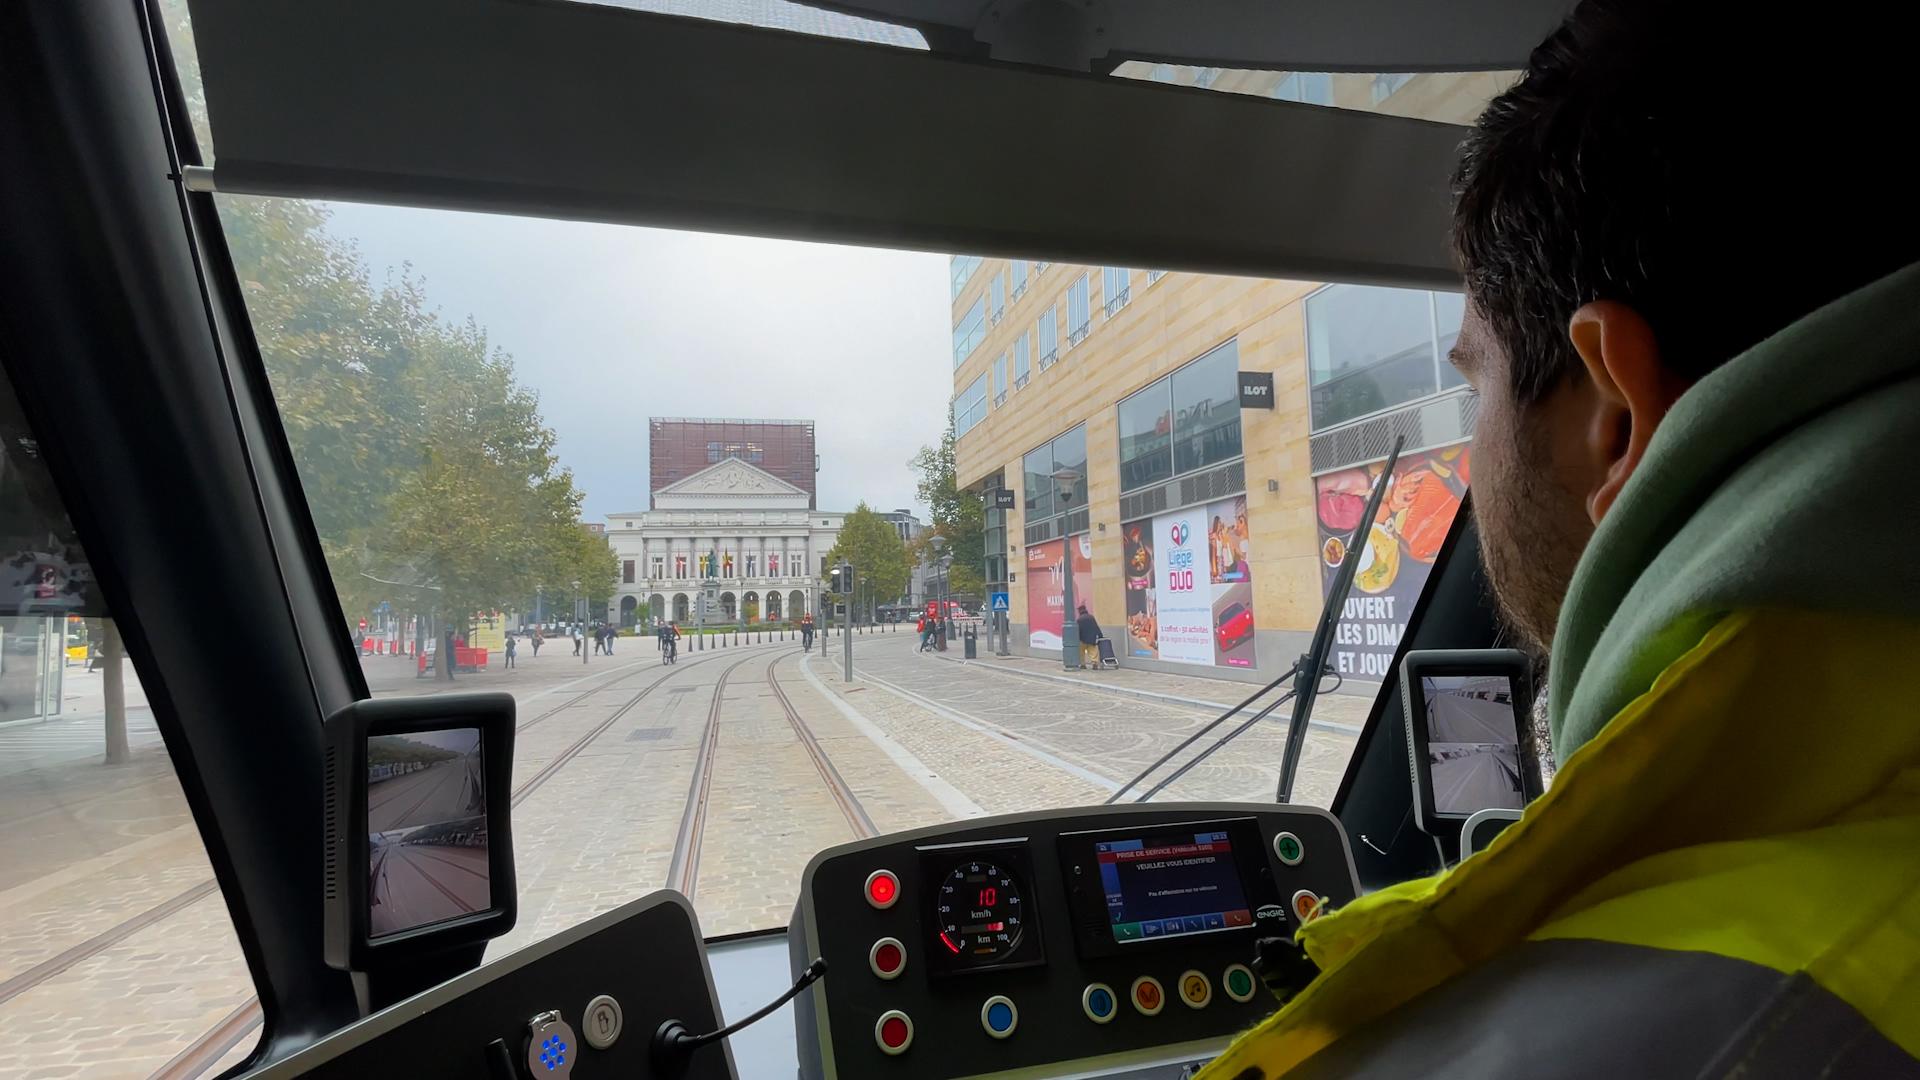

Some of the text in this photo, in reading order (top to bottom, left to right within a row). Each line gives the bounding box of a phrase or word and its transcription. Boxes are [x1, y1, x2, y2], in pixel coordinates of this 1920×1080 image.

[1244, 386, 1267, 395] ILOT
[1170, 570, 1193, 591] DUO
[1336, 623, 1362, 645] LES
[1338, 651, 1393, 676] ET JOU
[980, 888, 996, 906] 10
[971, 910, 991, 918] km/h
